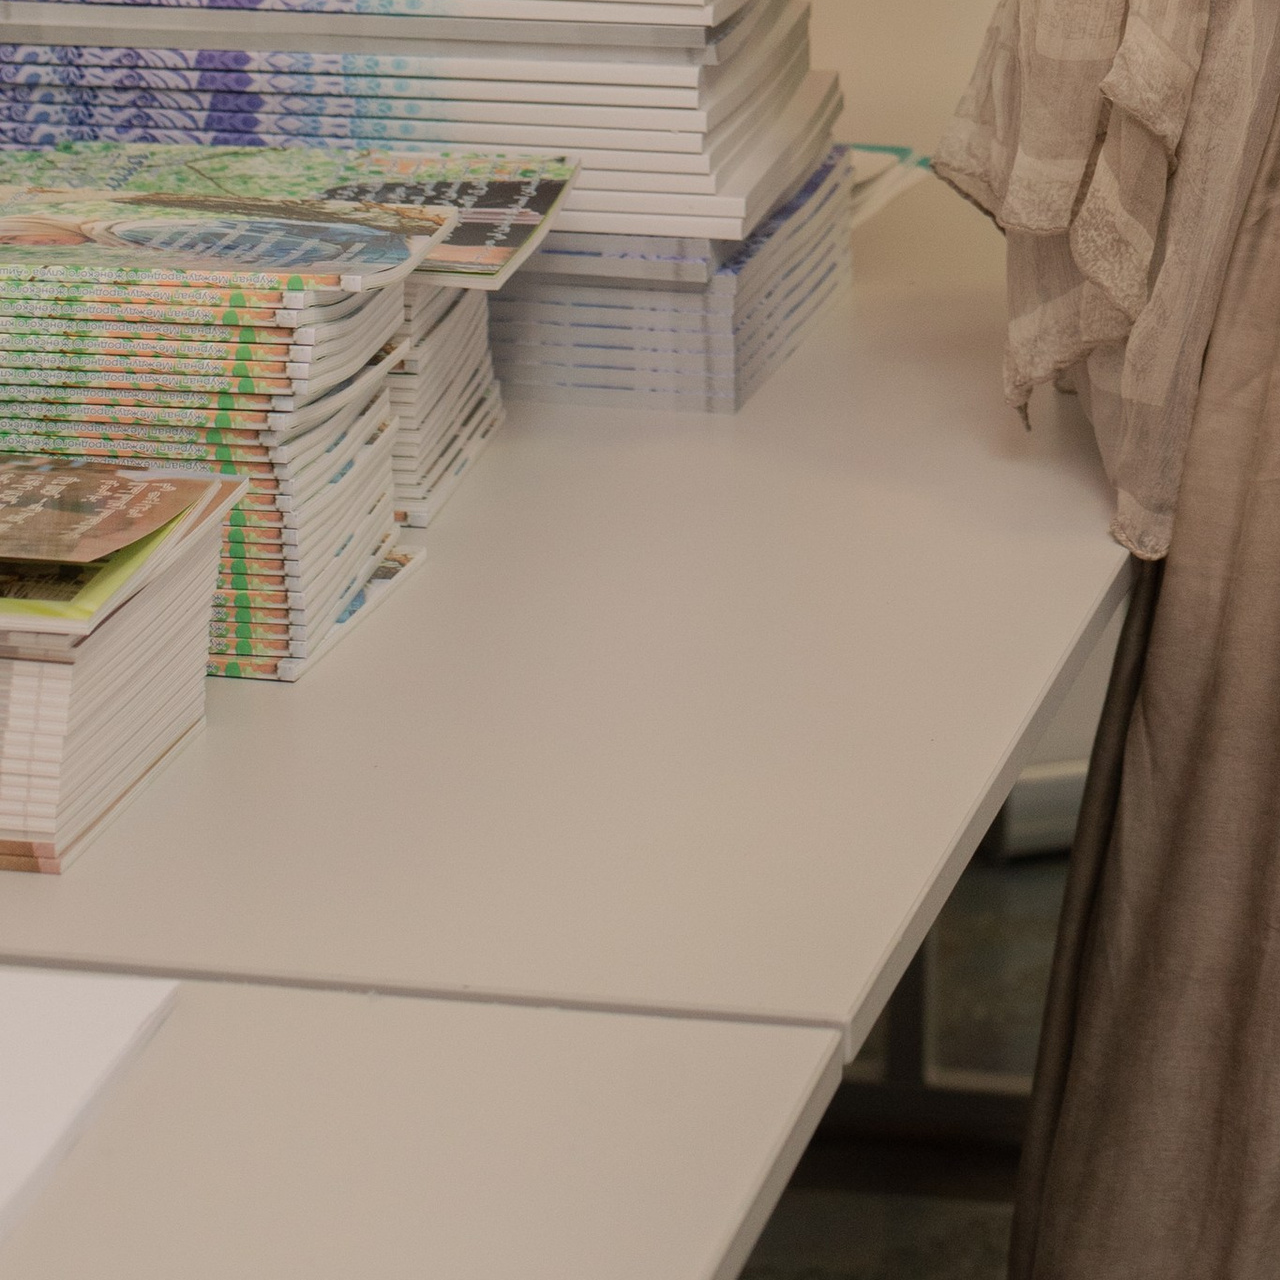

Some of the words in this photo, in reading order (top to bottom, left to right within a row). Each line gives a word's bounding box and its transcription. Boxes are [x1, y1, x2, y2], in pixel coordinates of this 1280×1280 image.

[33, 268, 65, 278] клуба
[69, 269, 124, 279] Женского
[127, 270, 228, 283] Международного
[232, 273, 276, 284] Журнал
[10, 285, 66, 296] Женского
[69, 287, 171, 299] Международного
[174, 290, 219, 302] Журнал
[3, 303, 60, 313] Женского
[63, 305, 165, 317] Международного
[168, 309, 212, 320] Журнал
[18, 320, 75, 331] Женского
[79, 322, 180, 335] Международного
[184, 326, 228, 337] Журнал
[14, 338, 71, 349] Женского
[74, 340, 176, 353] Международного
[180, 344, 225, 356] Журнал
[11, 355, 67, 366] Женского
[70, 357, 172, 369] Международного
[177, 361, 222, 373] Журнал
[17, 370, 74, 381] Женского
[78, 372, 180, 385] Международного
[183, 376, 228, 388] Журнал
[56, 388, 158, 401] Международного
[161, 392, 208, 403] Журнал
[57, 405, 157, 419] Международного
[160, 411, 206, 422] Журнал
[46, 422, 148, 435] Международного
[150, 426, 196, 438] Журнал
[54, 439, 157, 452] Международного
[160, 443, 206, 455] Журнал
[164, 461, 210, 473] Журнал
